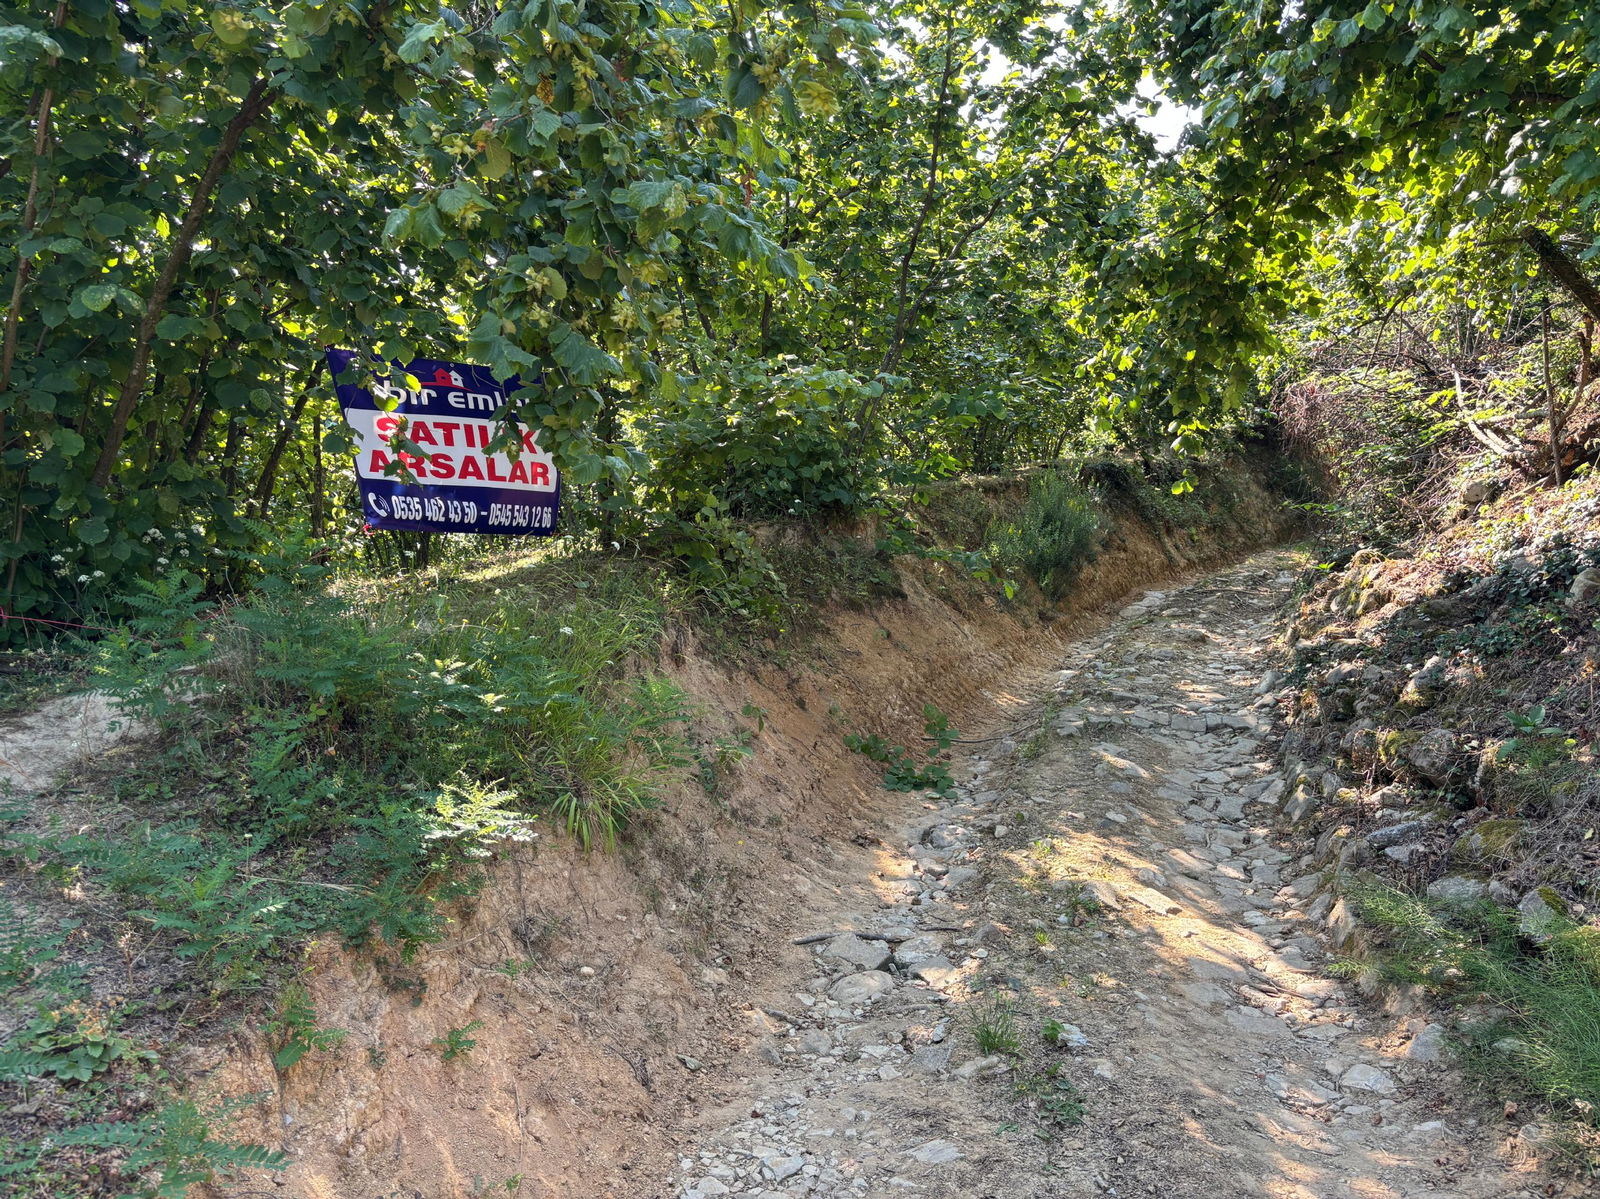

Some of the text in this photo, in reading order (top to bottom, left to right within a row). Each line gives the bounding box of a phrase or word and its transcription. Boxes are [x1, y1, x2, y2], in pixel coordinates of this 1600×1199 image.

[369, 450, 550, 486] ARSALAR
[391, 496, 422, 520] 0535
[425, 498, 446, 523] 462
[448, 500, 461, 523] 43
[464, 502, 478, 524] 50
[488, 503, 512, 526] 0545
[512, 505, 529, 528] 543
[531, 506, 541, 528] 12
[541, 507, 552, 529] 66
